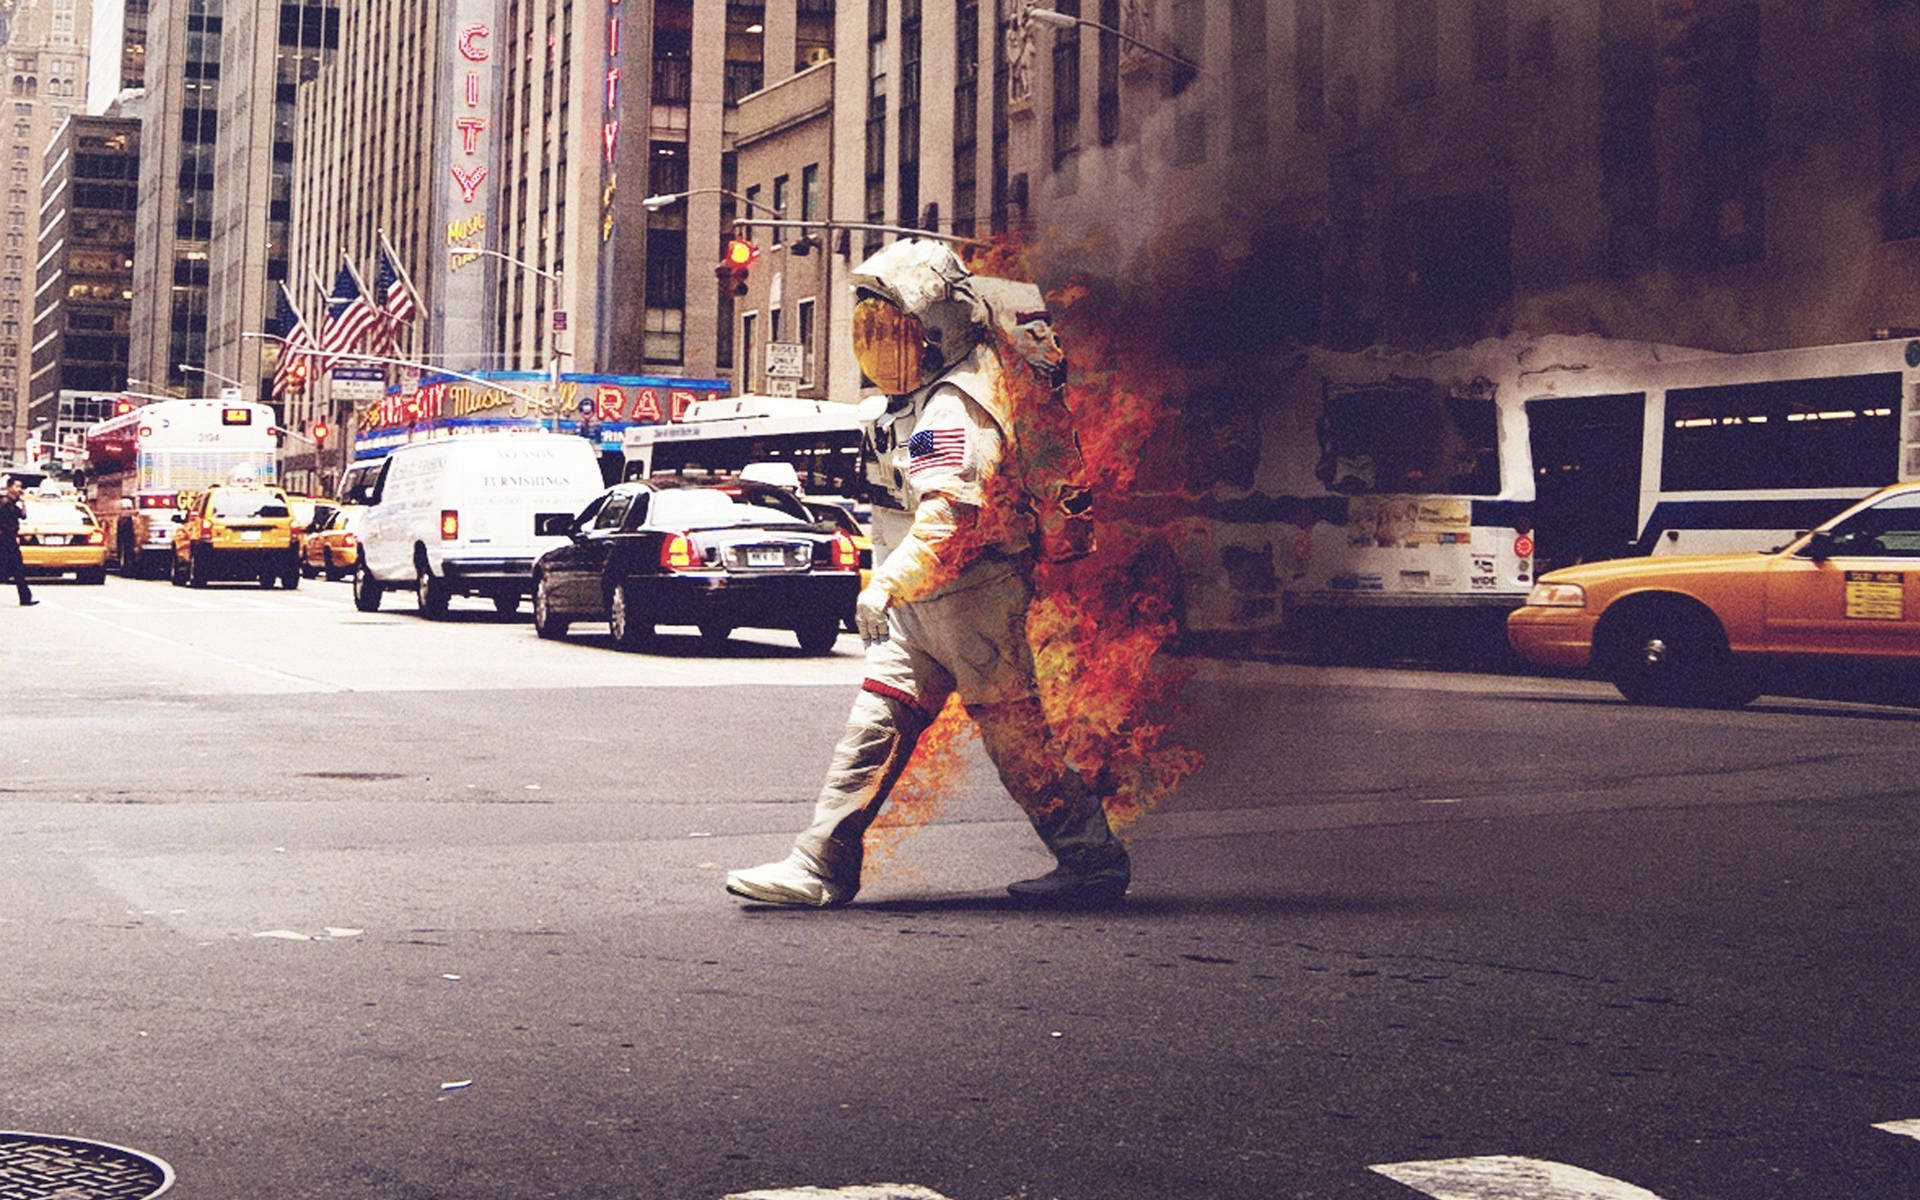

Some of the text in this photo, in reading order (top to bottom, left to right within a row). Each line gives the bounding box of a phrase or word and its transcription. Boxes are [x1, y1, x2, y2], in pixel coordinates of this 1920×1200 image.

[451, 22, 490, 203] CITY
[602, 0, 619, 163] ITY
[483, 476, 571, 487] FURNISHINGS
